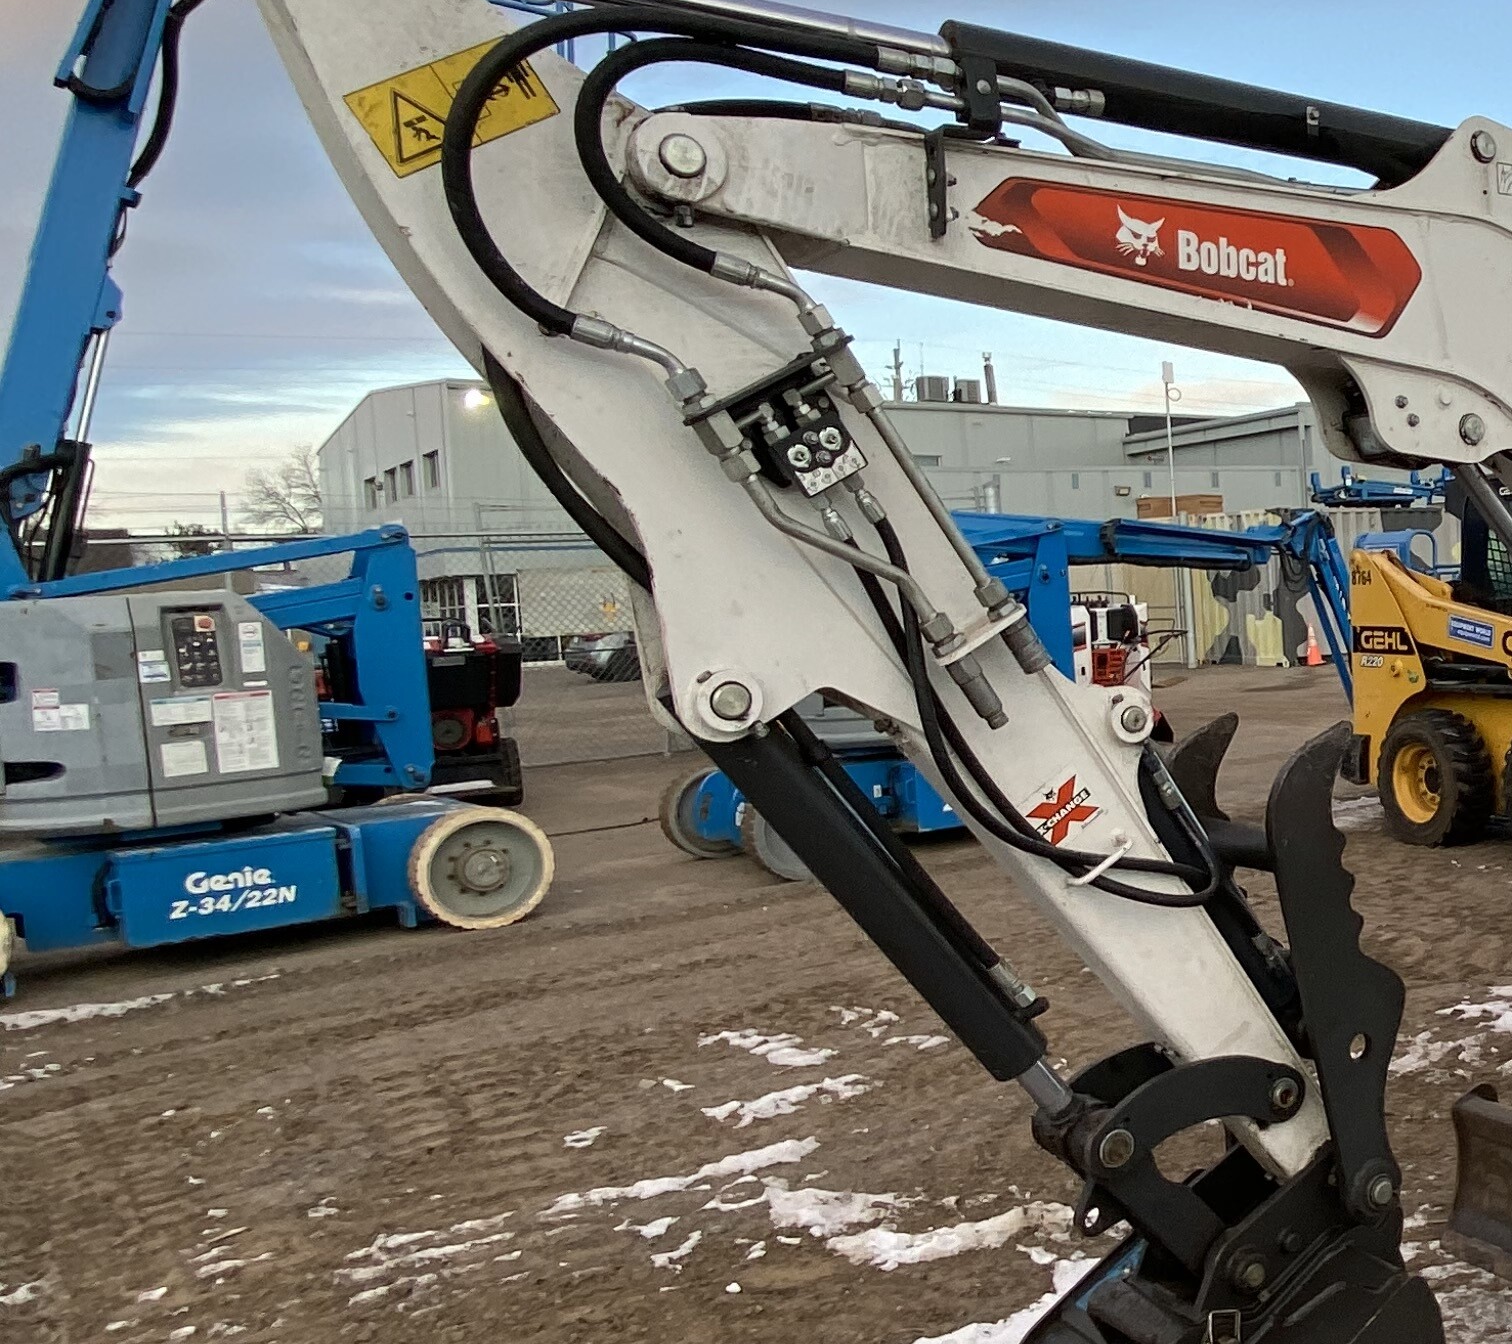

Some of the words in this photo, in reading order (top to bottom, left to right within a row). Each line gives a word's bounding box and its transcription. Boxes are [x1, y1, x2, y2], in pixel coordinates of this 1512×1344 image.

[1177, 229, 1287, 286] Bobcat
[1360, 630, 1408, 651] GEHL
[185, 865, 272, 895] Genie
[169, 885, 298, 920] Z-34/22N
